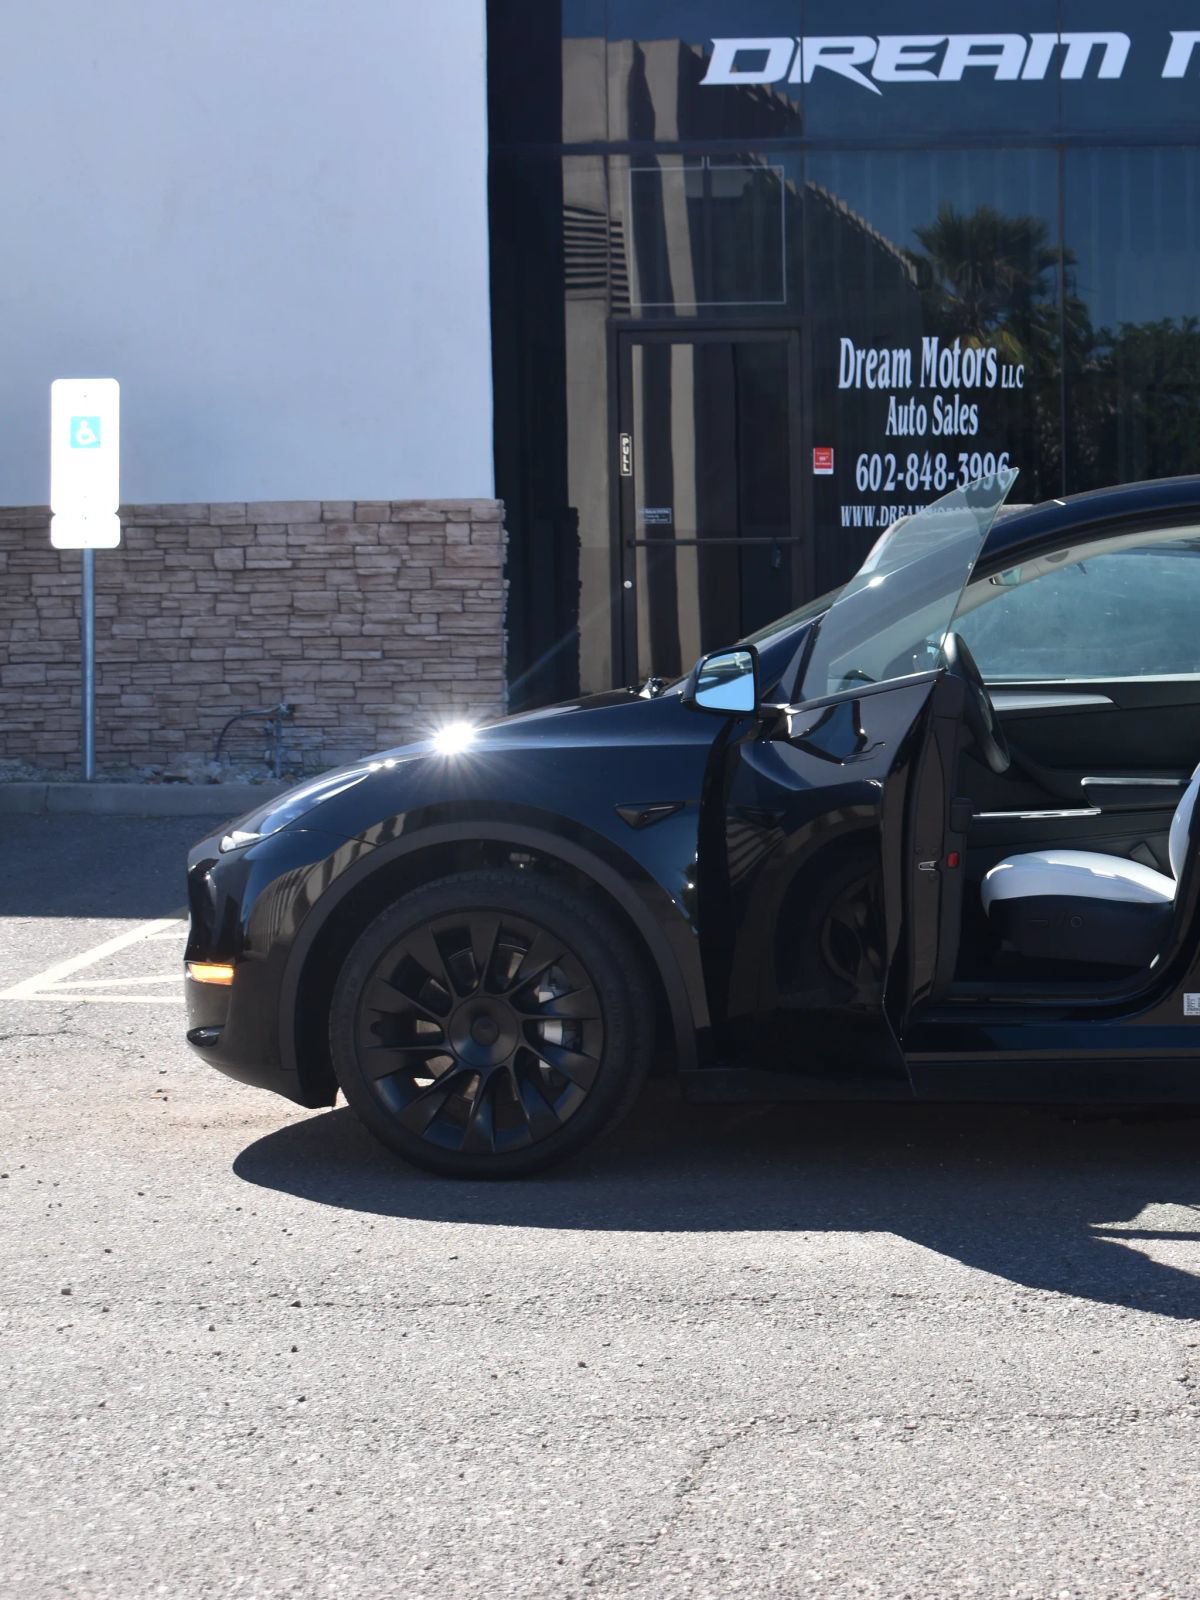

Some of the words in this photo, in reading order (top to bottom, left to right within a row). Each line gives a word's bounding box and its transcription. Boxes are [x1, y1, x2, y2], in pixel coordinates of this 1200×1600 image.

[699, 32, 1132, 96] DREAM
[838, 337, 912, 389] Dream
[920, 336, 998, 389] Motors
[1001, 364, 1025, 389] LLC
[885, 396, 928, 436] Auto
[932, 394, 979, 436] Sales
[855, 452, 1011, 493] 602-848-3996
